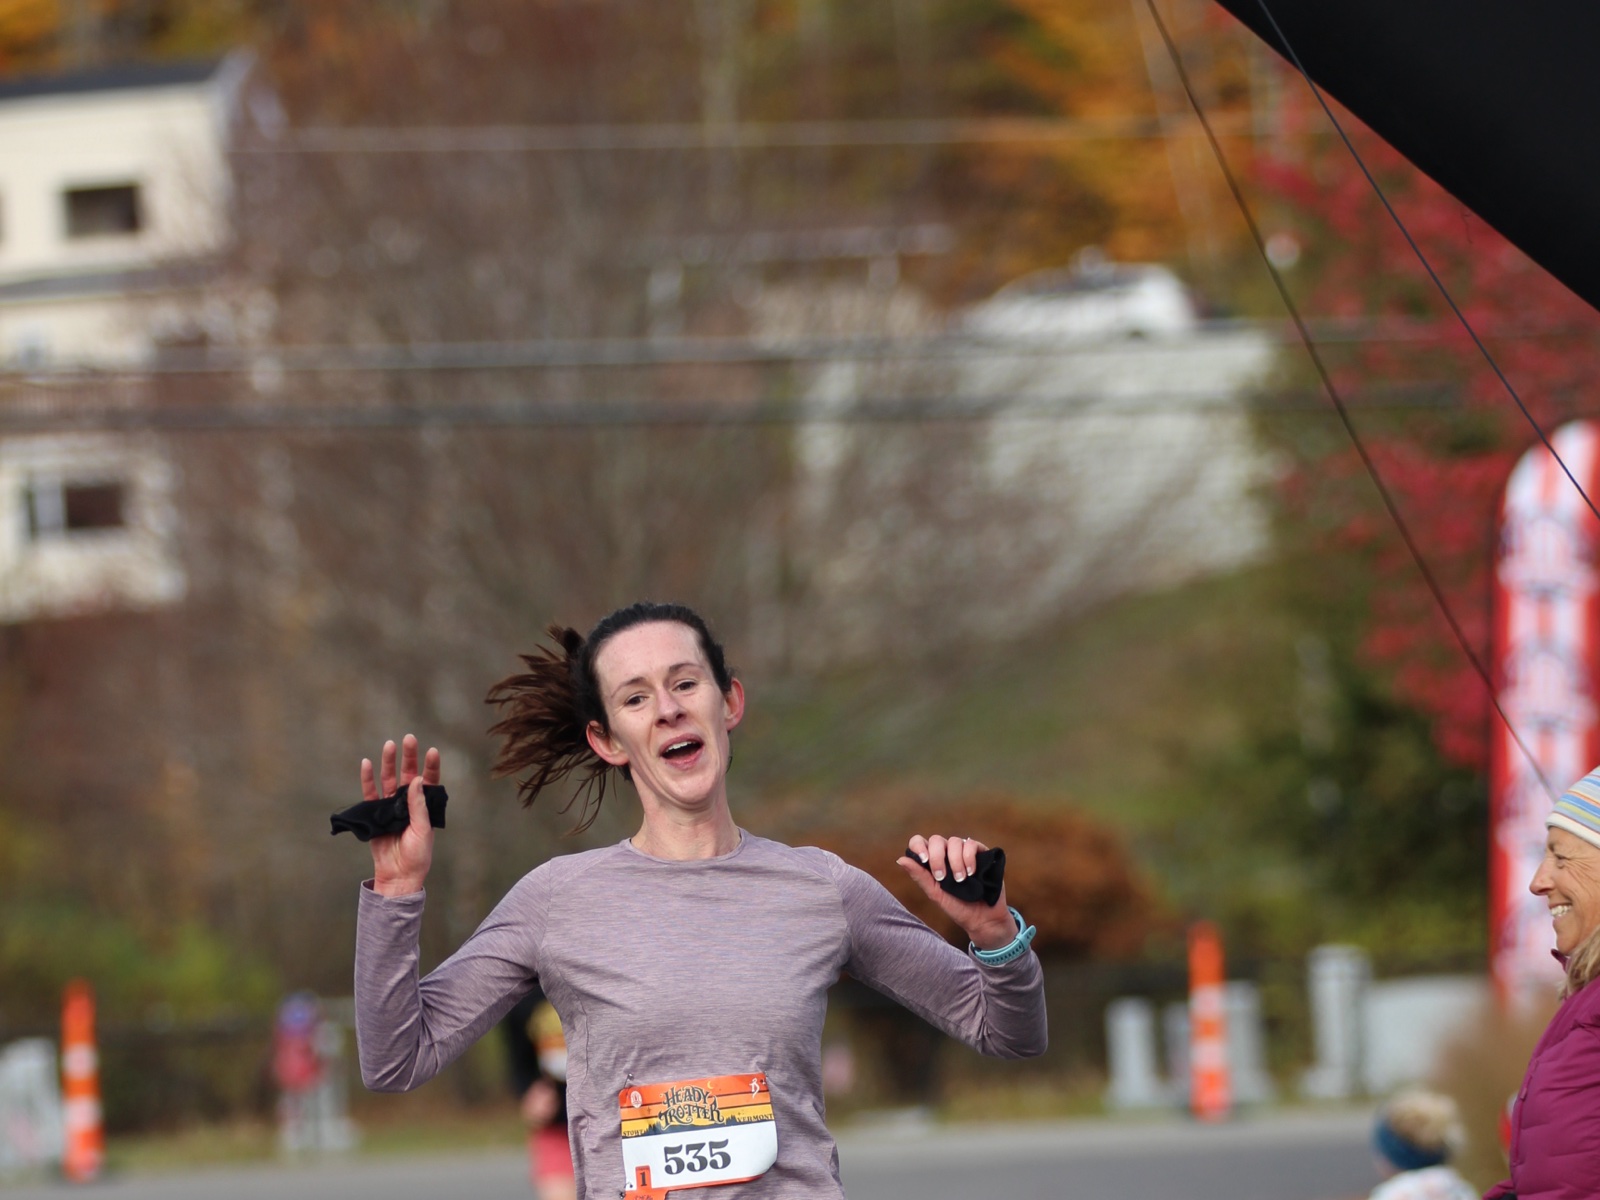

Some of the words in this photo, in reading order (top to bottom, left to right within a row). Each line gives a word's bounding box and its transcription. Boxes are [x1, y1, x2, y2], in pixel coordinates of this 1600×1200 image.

[661, 1086, 712, 1108] HEADY
[658, 1097, 725, 1128] TROTTER
[737, 1113, 774, 1122] VERMONT
[663, 1138, 732, 1175] 535
[639, 1171, 648, 1187] 1
